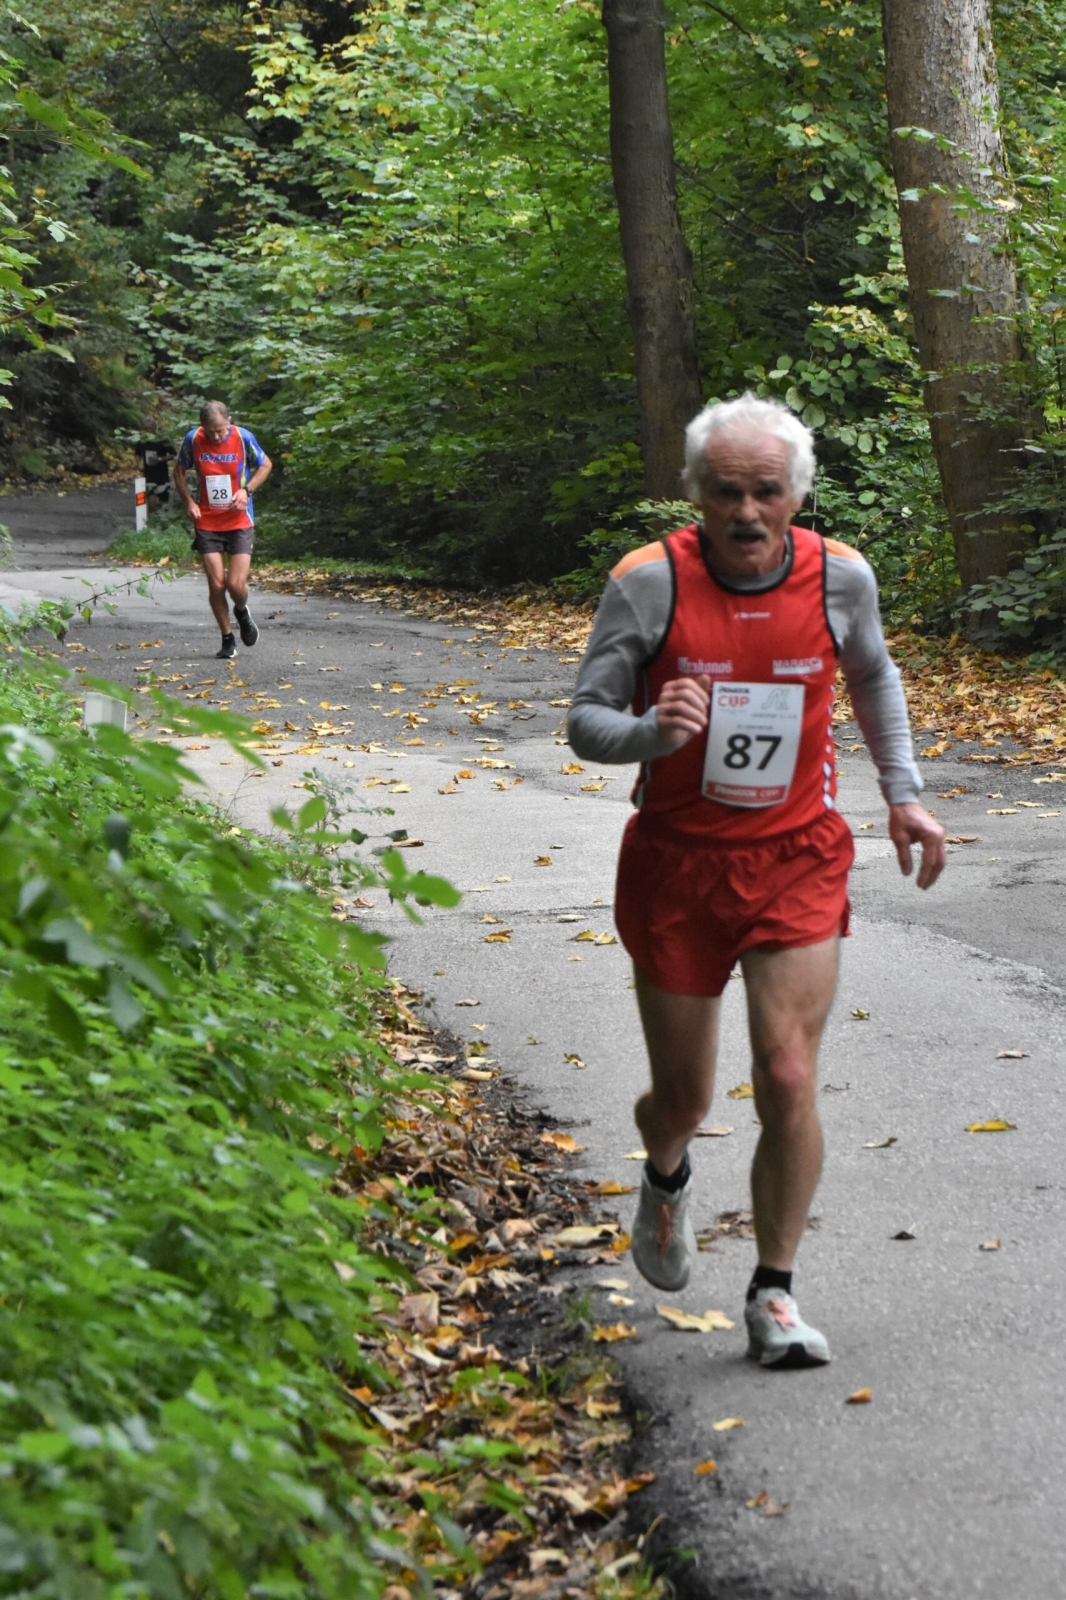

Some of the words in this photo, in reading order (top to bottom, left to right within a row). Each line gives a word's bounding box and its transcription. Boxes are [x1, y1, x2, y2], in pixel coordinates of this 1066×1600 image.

[212, 489, 228, 500] 28
[717, 695, 750, 707] CUP
[723, 733, 783, 771] 87
